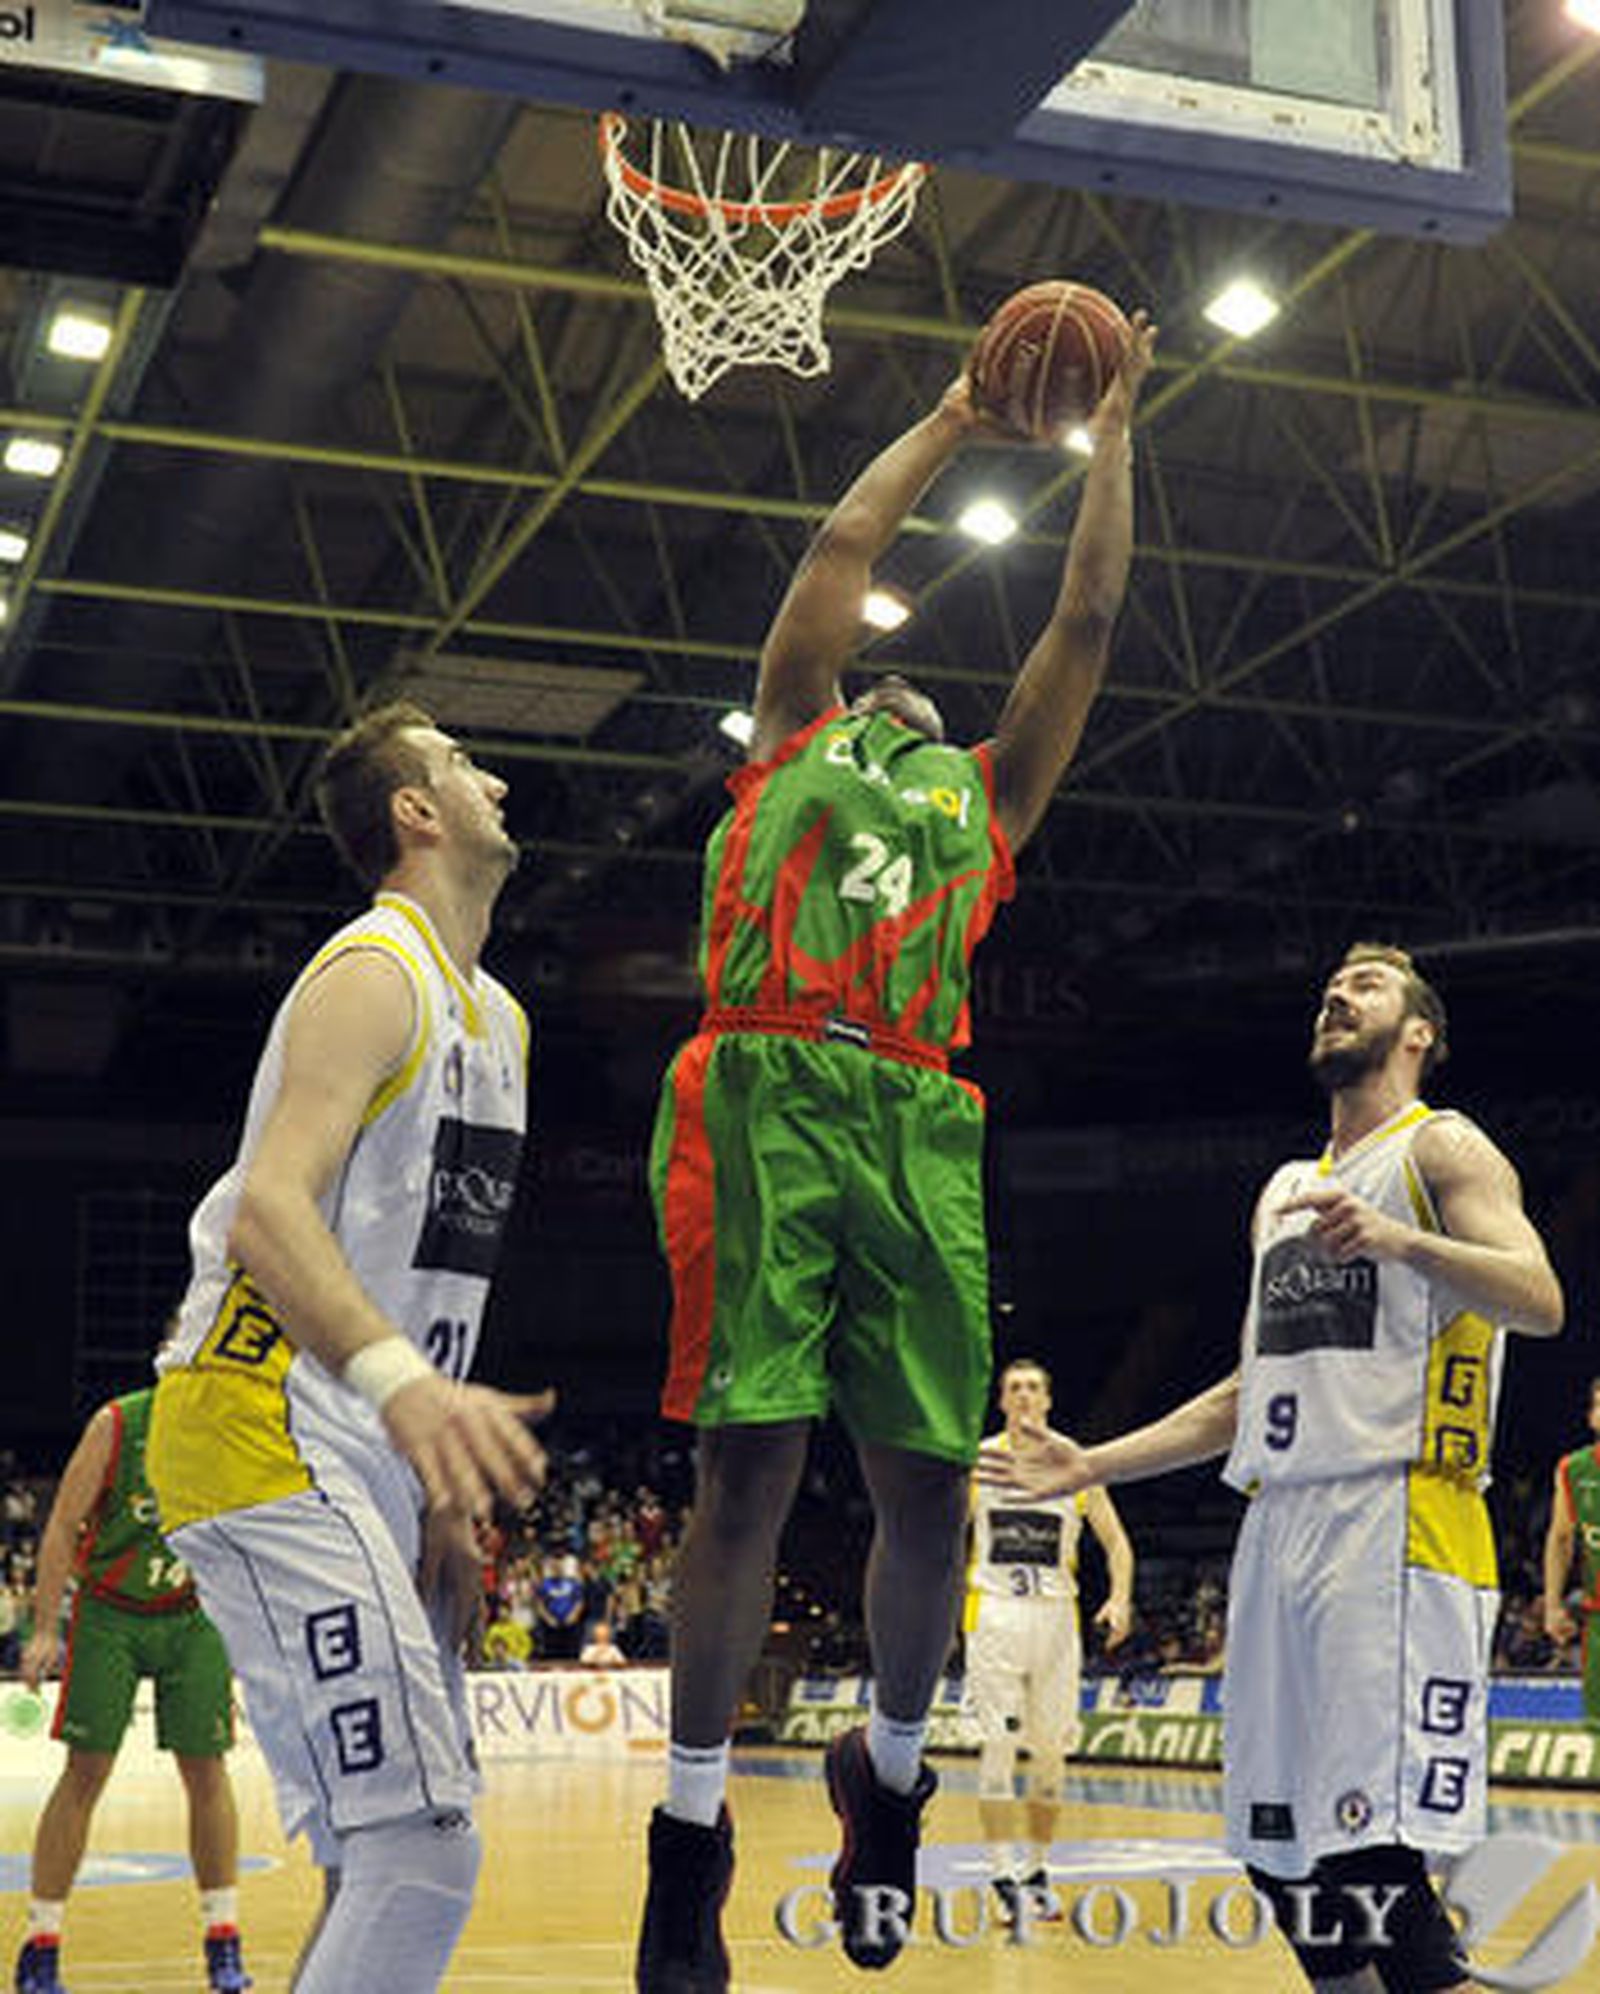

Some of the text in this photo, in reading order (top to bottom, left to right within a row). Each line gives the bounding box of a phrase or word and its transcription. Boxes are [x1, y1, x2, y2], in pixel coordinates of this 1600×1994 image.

[839, 832, 912, 918] 24
[1264, 1393, 1298, 1451] 9
[1009, 1567, 1041, 1597] 31
